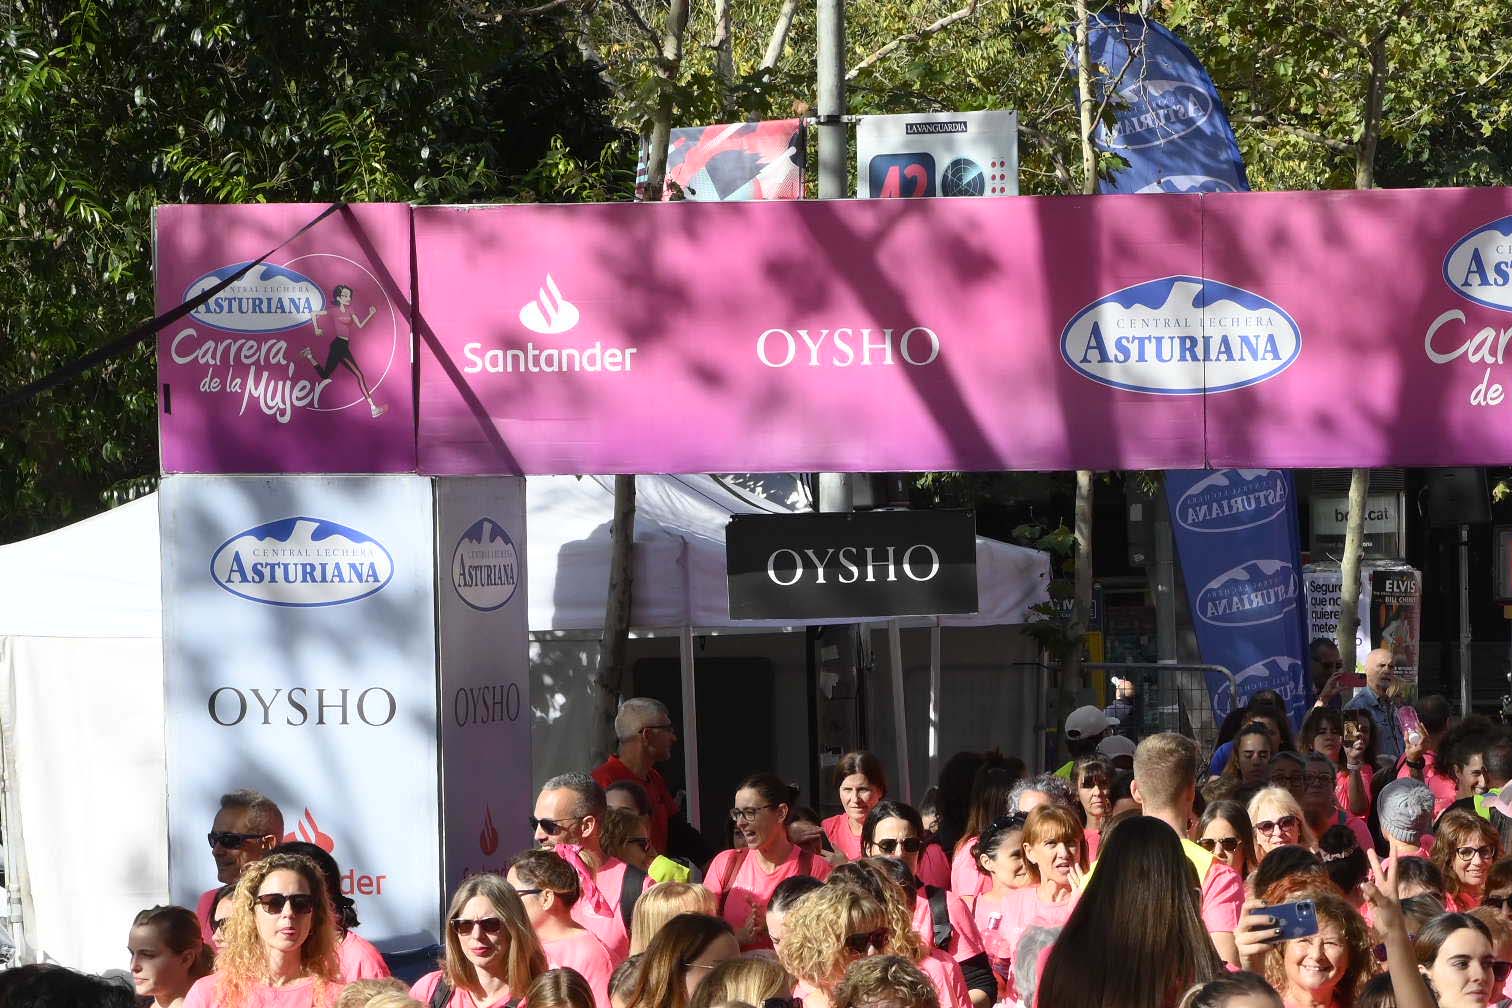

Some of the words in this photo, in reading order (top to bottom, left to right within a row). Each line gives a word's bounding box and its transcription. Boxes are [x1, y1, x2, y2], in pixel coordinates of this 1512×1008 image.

[1117, 317, 1191, 329] CENTRAL
[1199, 316, 1274, 328] LECHERA
[171, 328, 289, 366] Carrera
[463, 341, 637, 374] Santander
[756, 326, 940, 368] OYSHO
[1080, 321, 1282, 364] ASTURIANA
[200, 368, 221, 393] de
[226, 369, 242, 393] la
[239, 363, 332, 424] Mujer
[1470, 368, 1504, 406] de
[225, 551, 382, 585] ASTURIANA
[253, 549, 311, 558] CENTRAL
[315, 549, 375, 558] LECHERA
[457, 553, 515, 588] ASTURIANA
[767, 544, 940, 586] OYSHO
[1385, 580, 1416, 592] ELVIS
[1311, 609, 1343, 622] quiere
[208, 686, 397, 727] OYSHO
[454, 683, 520, 727] OYSHO
